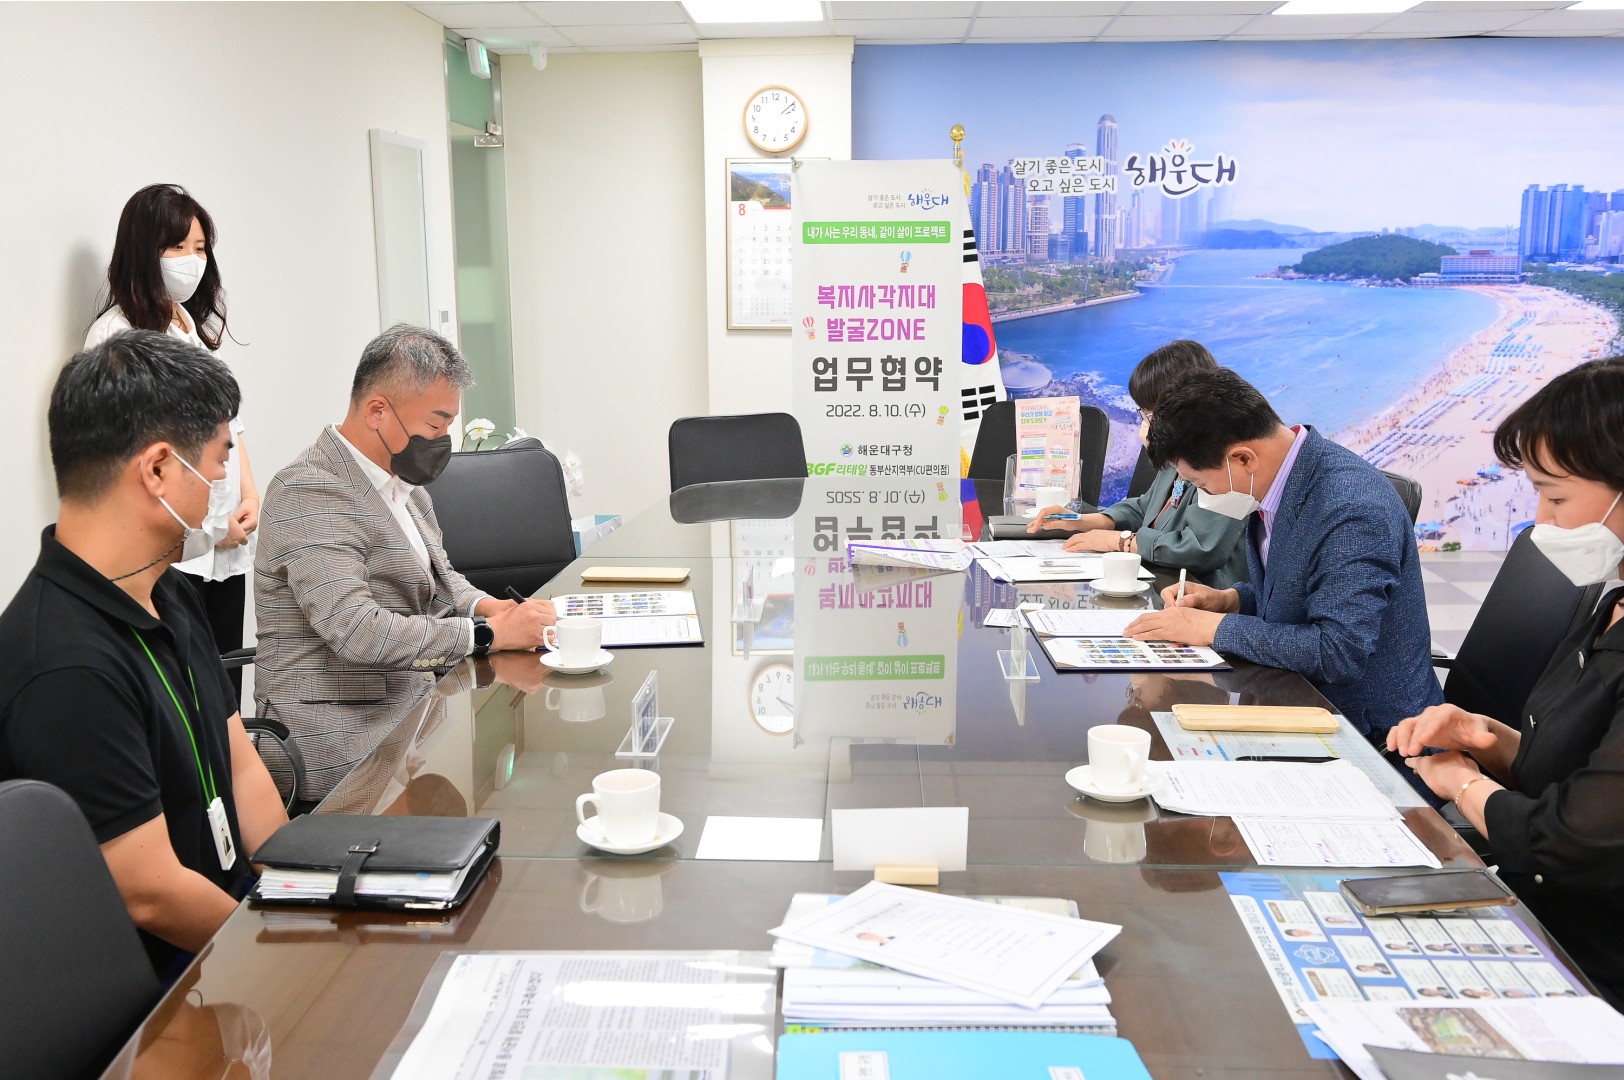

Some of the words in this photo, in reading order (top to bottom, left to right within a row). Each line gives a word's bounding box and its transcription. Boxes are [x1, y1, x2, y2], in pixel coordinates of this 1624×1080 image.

[761, 96, 768, 104] 11
[771, 92, 780, 101] 12
[753, 104, 761, 113] 10
[753, 125, 759, 134] 8
[762, 133, 767, 142] 7
[784, 133, 789, 142] 5
[1013, 159, 1041, 174] 살기
[1044, 158, 1071, 174] 좋은
[1075, 158, 1102, 173] 도시
[1124, 154, 1236, 196] 해운대
[1028, 178, 1054, 192] 오고
[1058, 178, 1085, 193] 싶은
[1088, 177, 1115, 192] 도시
[907, 193, 949, 210] 해운대
[738, 203, 746, 216] 8
[807, 226, 823, 239] 내가
[825, 226, 841, 239] 사는
[842, 226, 858, 239] 우리
[859, 226, 878, 240] 동네,
[879, 226, 895, 239] 같이
[897, 226, 913, 239] 살이
[914, 225, 947, 239] 프로젝트
[817, 284, 936, 310] 복지사각지대
[826, 318, 926, 343] 발굴ZONE
[812, 354, 943, 392] 업무협약
[826, 404, 865, 418] 2022.
[857, 444, 913, 457] 해운대구청
[869, 464, 950, 477] 동부산지역부(CU편의점)
